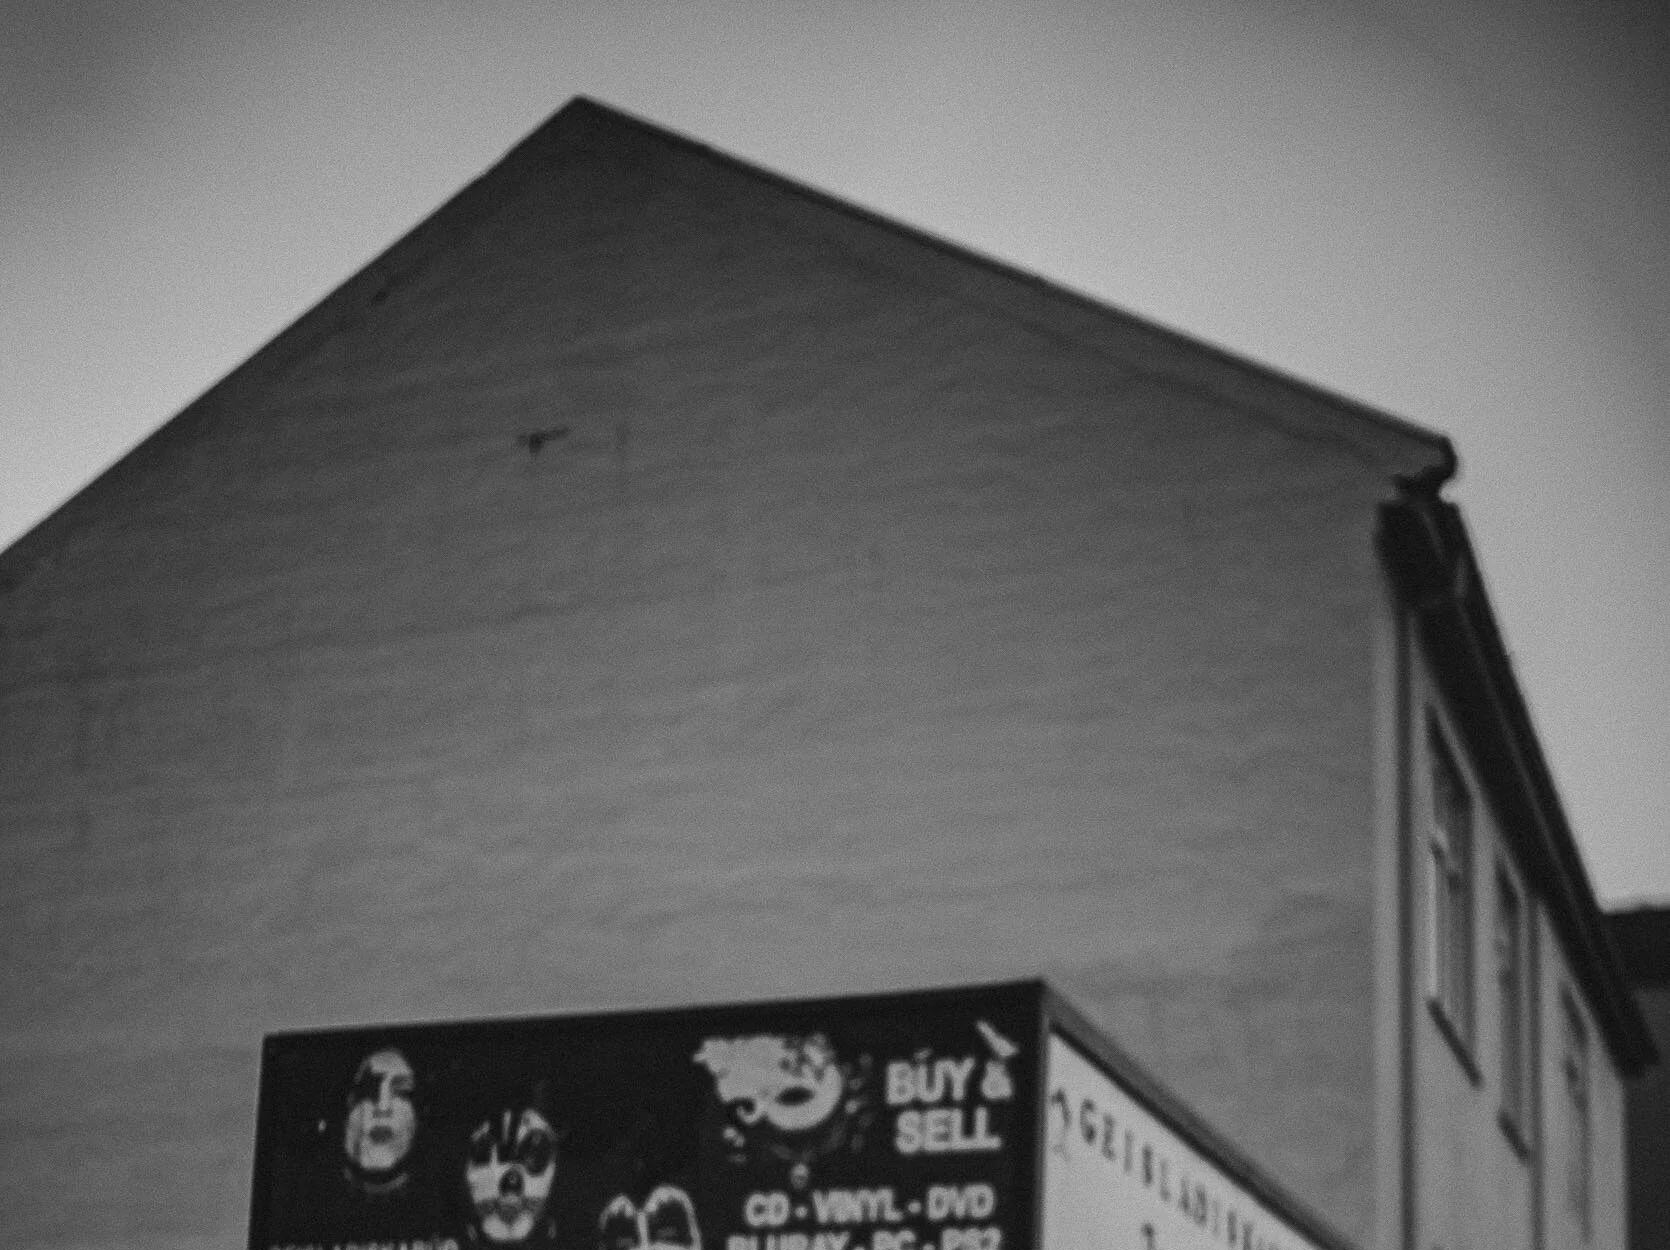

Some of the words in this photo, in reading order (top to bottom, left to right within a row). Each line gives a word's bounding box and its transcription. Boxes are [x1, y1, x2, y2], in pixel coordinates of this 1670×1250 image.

[886, 1058, 975, 1104] BUY
[896, 1107, 1001, 1154] SELL
[744, 1192, 789, 1226] CD
[812, 1187, 903, 1224] VINYL
[927, 1184, 995, 1220] DVD
